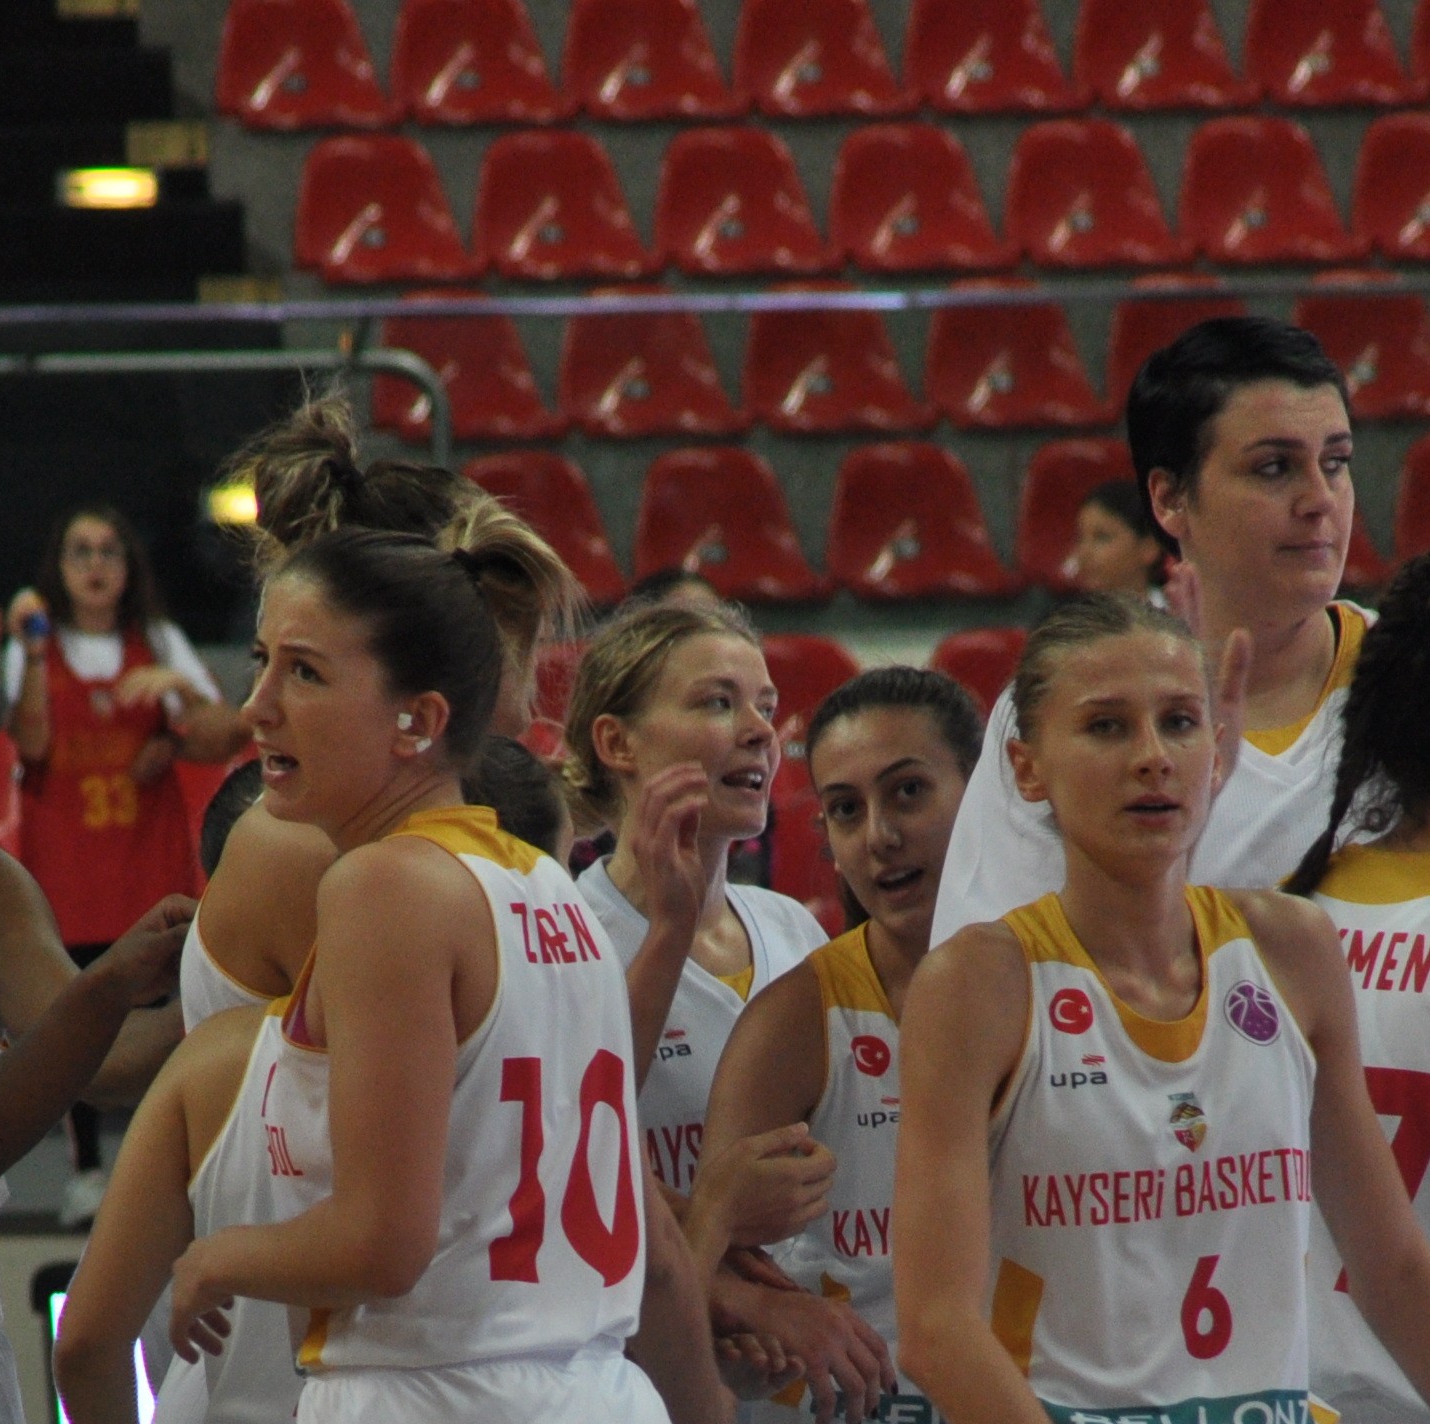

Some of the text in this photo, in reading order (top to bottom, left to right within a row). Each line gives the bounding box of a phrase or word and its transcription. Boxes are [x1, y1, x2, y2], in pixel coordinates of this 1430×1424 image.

[654, 1042, 693, 1061] pa
[1050, 1070, 1108, 1089] upa
[488, 1048, 640, 1288] 10
[1180, 1254, 1233, 1360] 6
